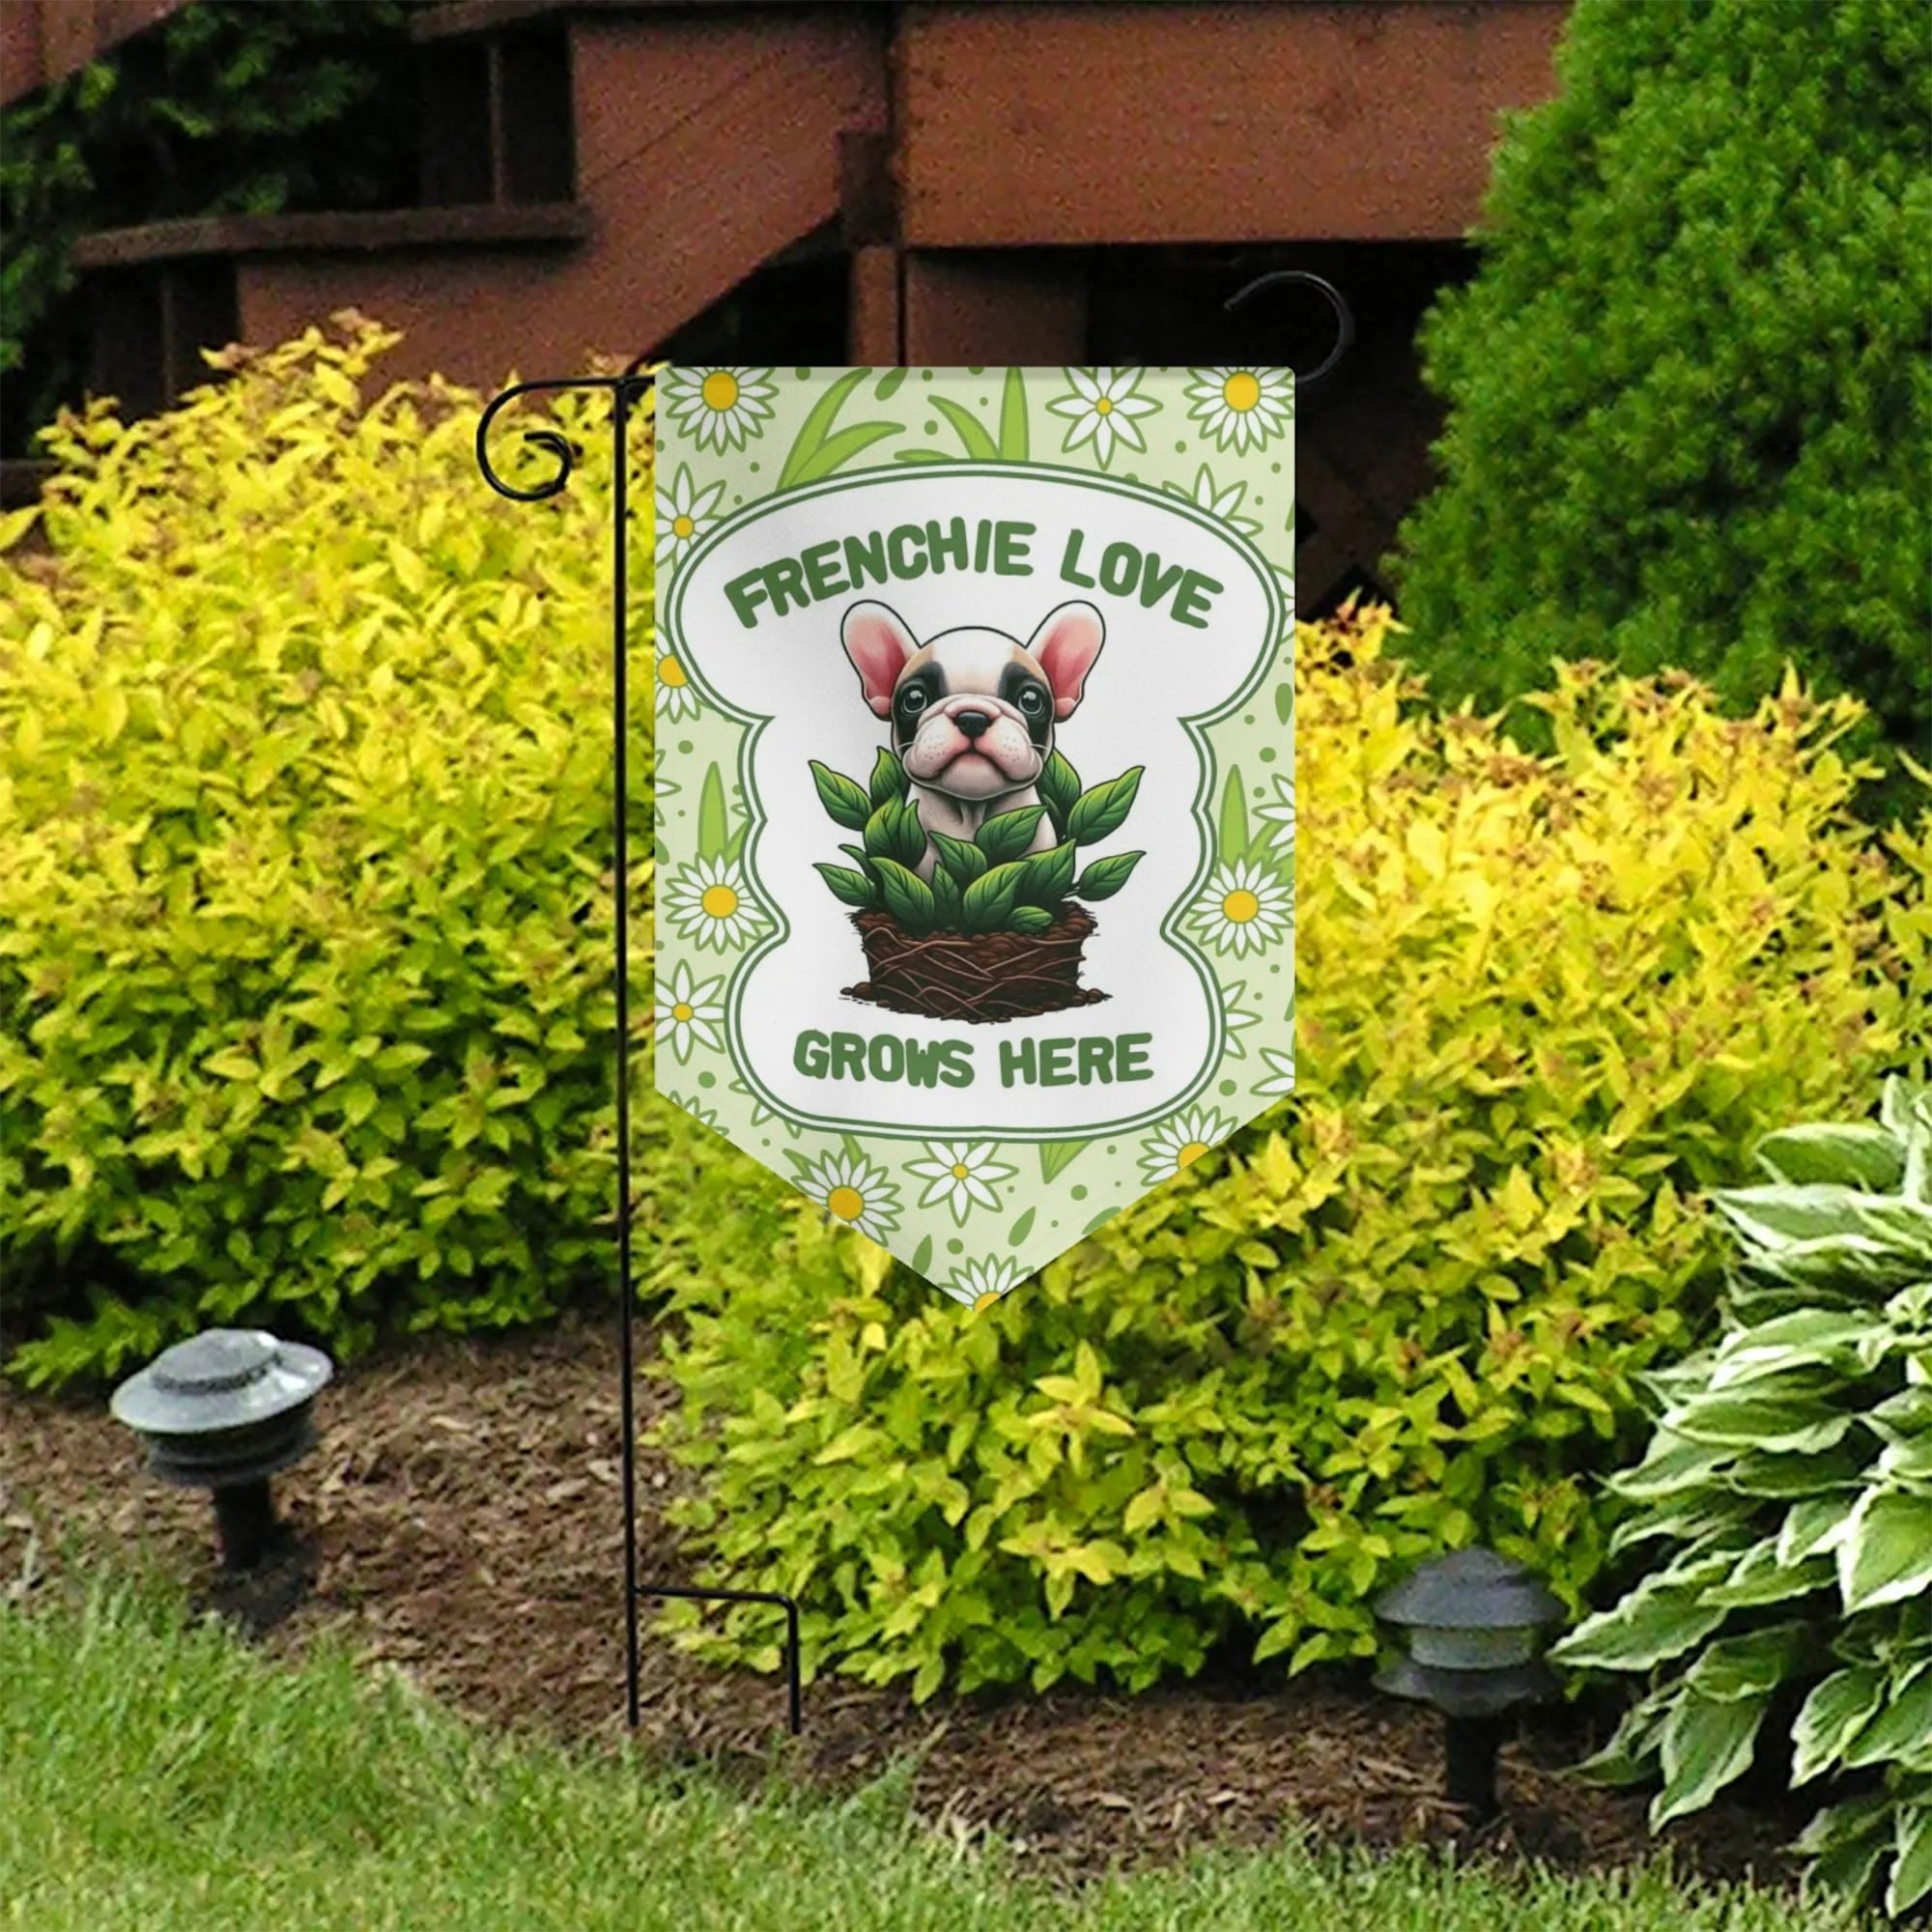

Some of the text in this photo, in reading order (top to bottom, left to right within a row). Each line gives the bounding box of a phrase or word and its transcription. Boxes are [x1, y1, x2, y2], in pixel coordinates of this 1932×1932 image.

[724, 516, 1225, 629] FRENCHIE LOVE
[793, 1029, 1154, 1089] GROWS HERE
